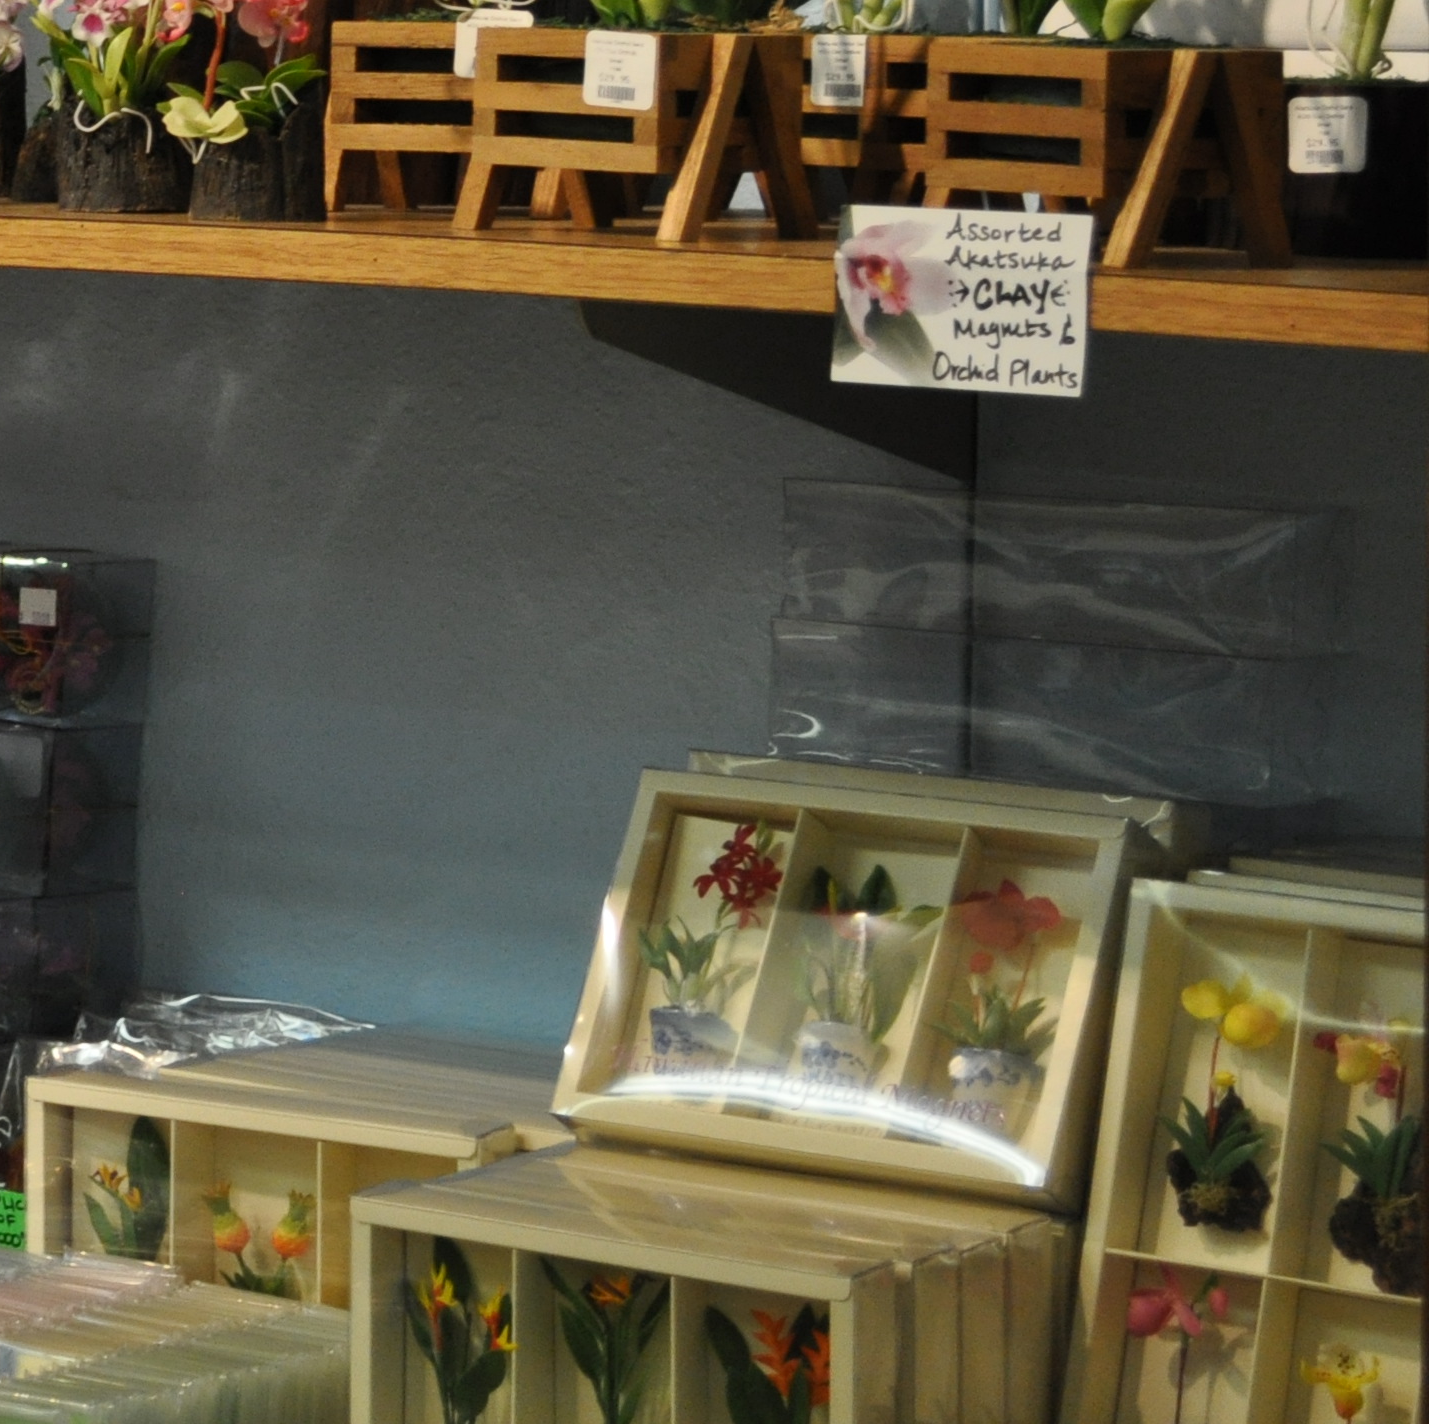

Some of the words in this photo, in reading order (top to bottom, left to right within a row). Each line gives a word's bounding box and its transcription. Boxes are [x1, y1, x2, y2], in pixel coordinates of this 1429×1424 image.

[945, 212, 1063, 243] Assorted
[944, 245, 1077, 271] Akatsuka
[972, 277, 1052, 315] CLAY
[952, 318, 1052, 350] Magnets
[931, 350, 1001, 383] Orchid
[1008, 358, 1079, 389] Plants
